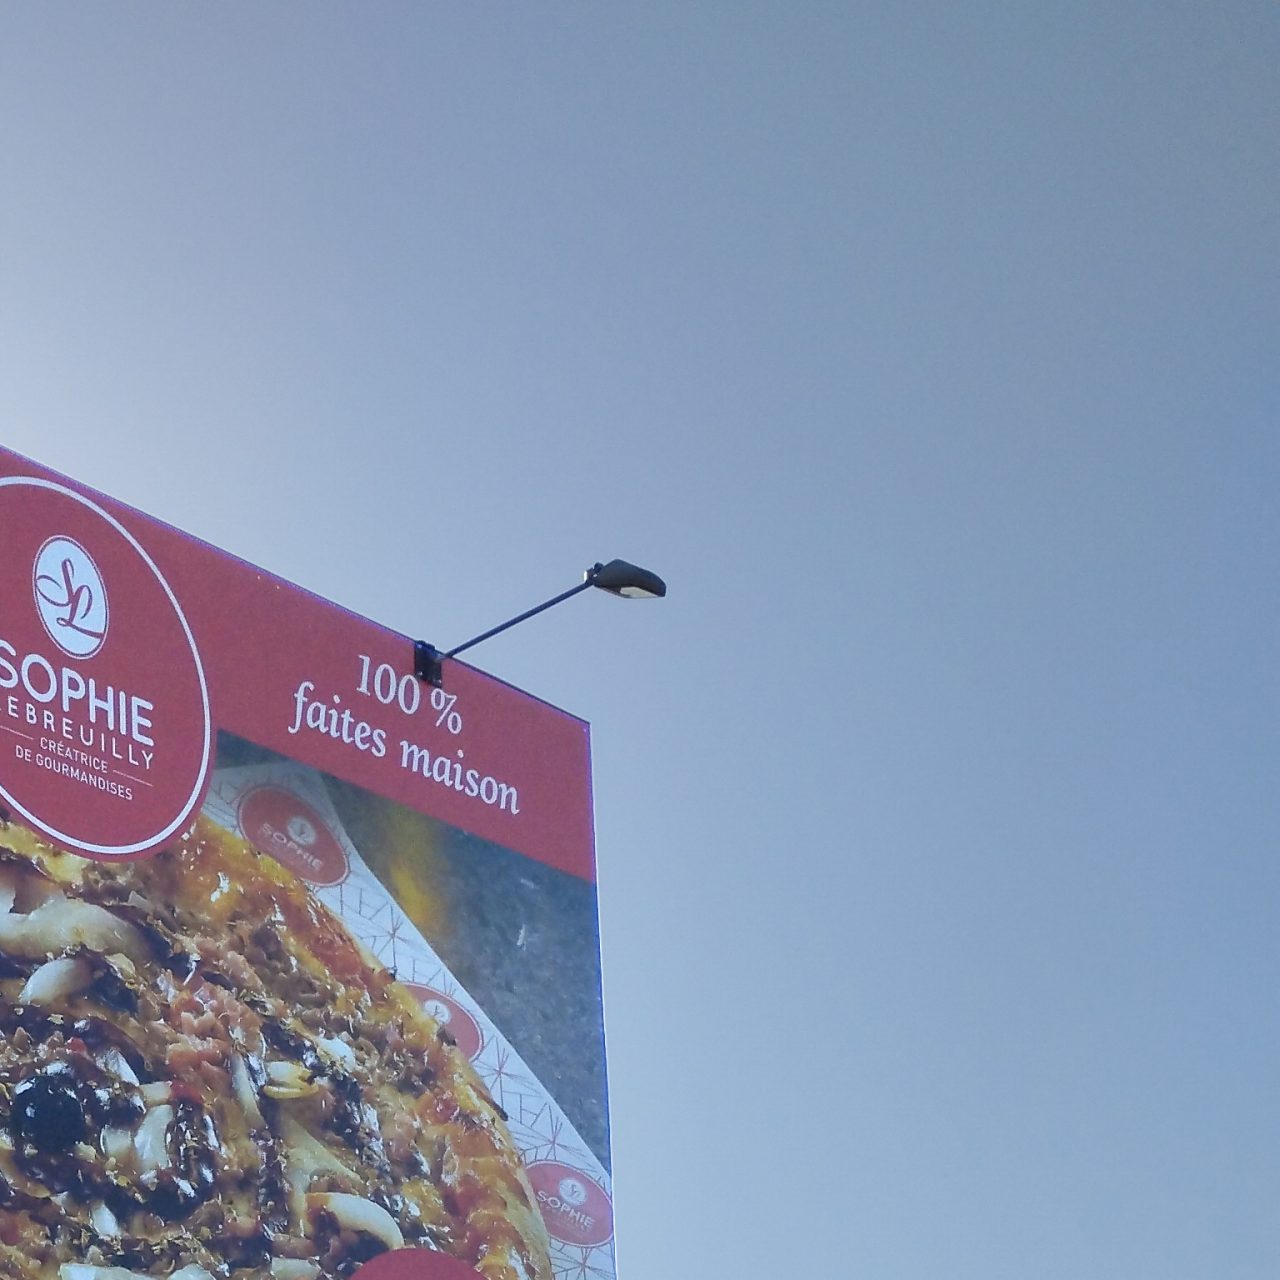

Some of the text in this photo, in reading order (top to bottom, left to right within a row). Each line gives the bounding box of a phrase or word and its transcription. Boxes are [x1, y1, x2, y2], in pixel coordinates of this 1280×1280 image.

[356, 653, 463, 736] 100 %
[15, 743, 134, 801] DE GOURMANDISES
[40, 735, 109, 774] CRÉATRICE
[288, 681, 520, 816] faites maison
[261, 822, 325, 871] SOPHIE
[537, 1190, 596, 1228] SOPHIE
